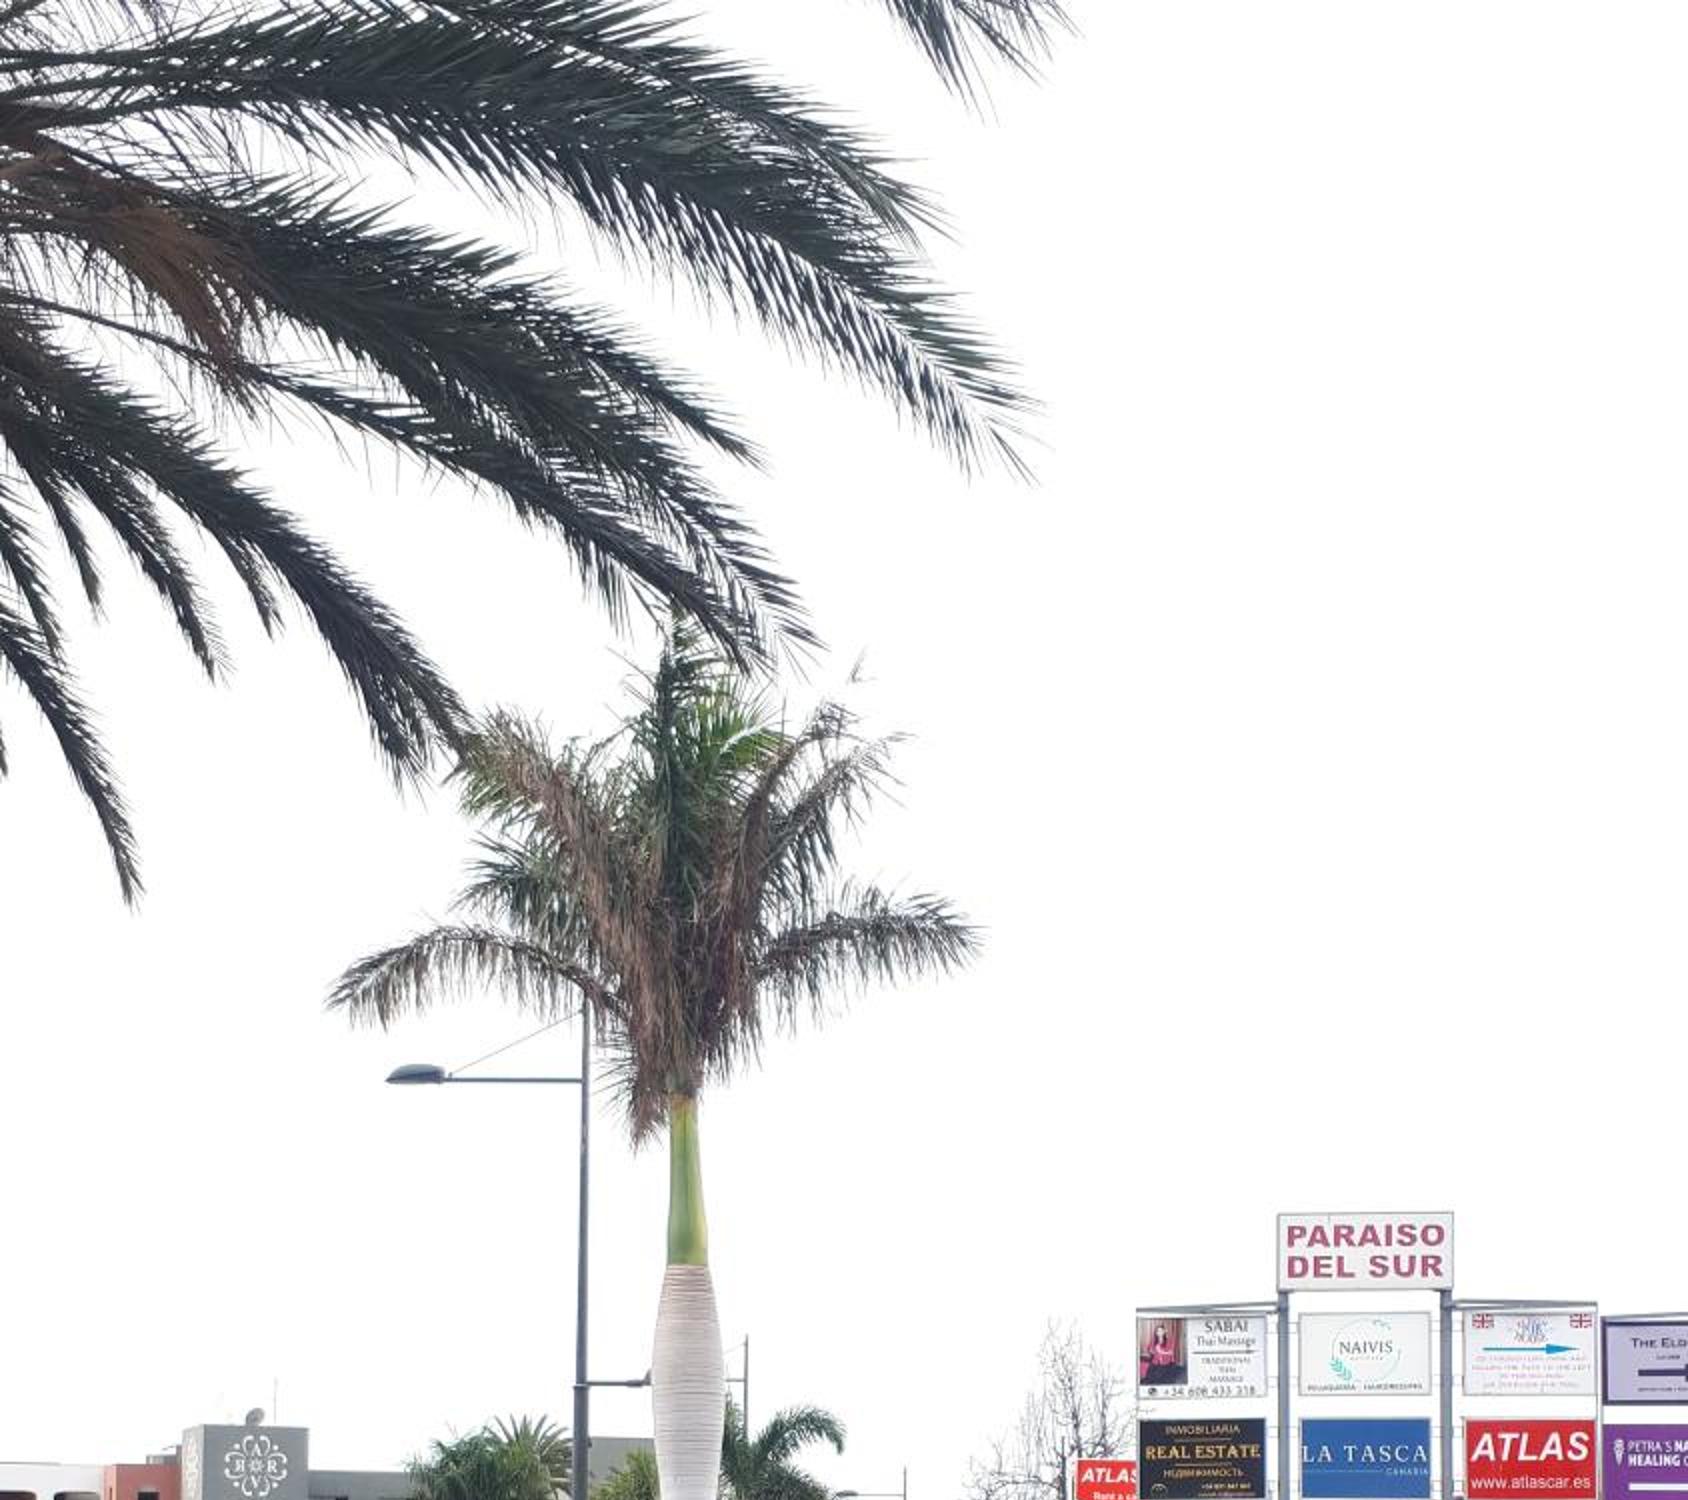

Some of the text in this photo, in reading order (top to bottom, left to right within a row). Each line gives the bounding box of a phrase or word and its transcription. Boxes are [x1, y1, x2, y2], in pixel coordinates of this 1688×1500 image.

[1287, 1224, 1445, 1248] PARAISO
[1287, 1255, 1443, 1278] DEL SUR
[1218, 1335, 1257, 1348] Massage
[1339, 1340, 1393, 1354] NAIVIS
[1631, 1337, 1656, 1348] THE
[1165, 1424, 1241, 1435] INMOBILIARIA
[1145, 1443, 1261, 1460] REAL ESTATE
[1470, 1431, 1590, 1461] ATLAS
[1301, 1445, 1427, 1463] LA TASCA
[1628, 1453, 1681, 1467] HEALING
[1471, 1474, 1591, 1489] www.atlascar.es
